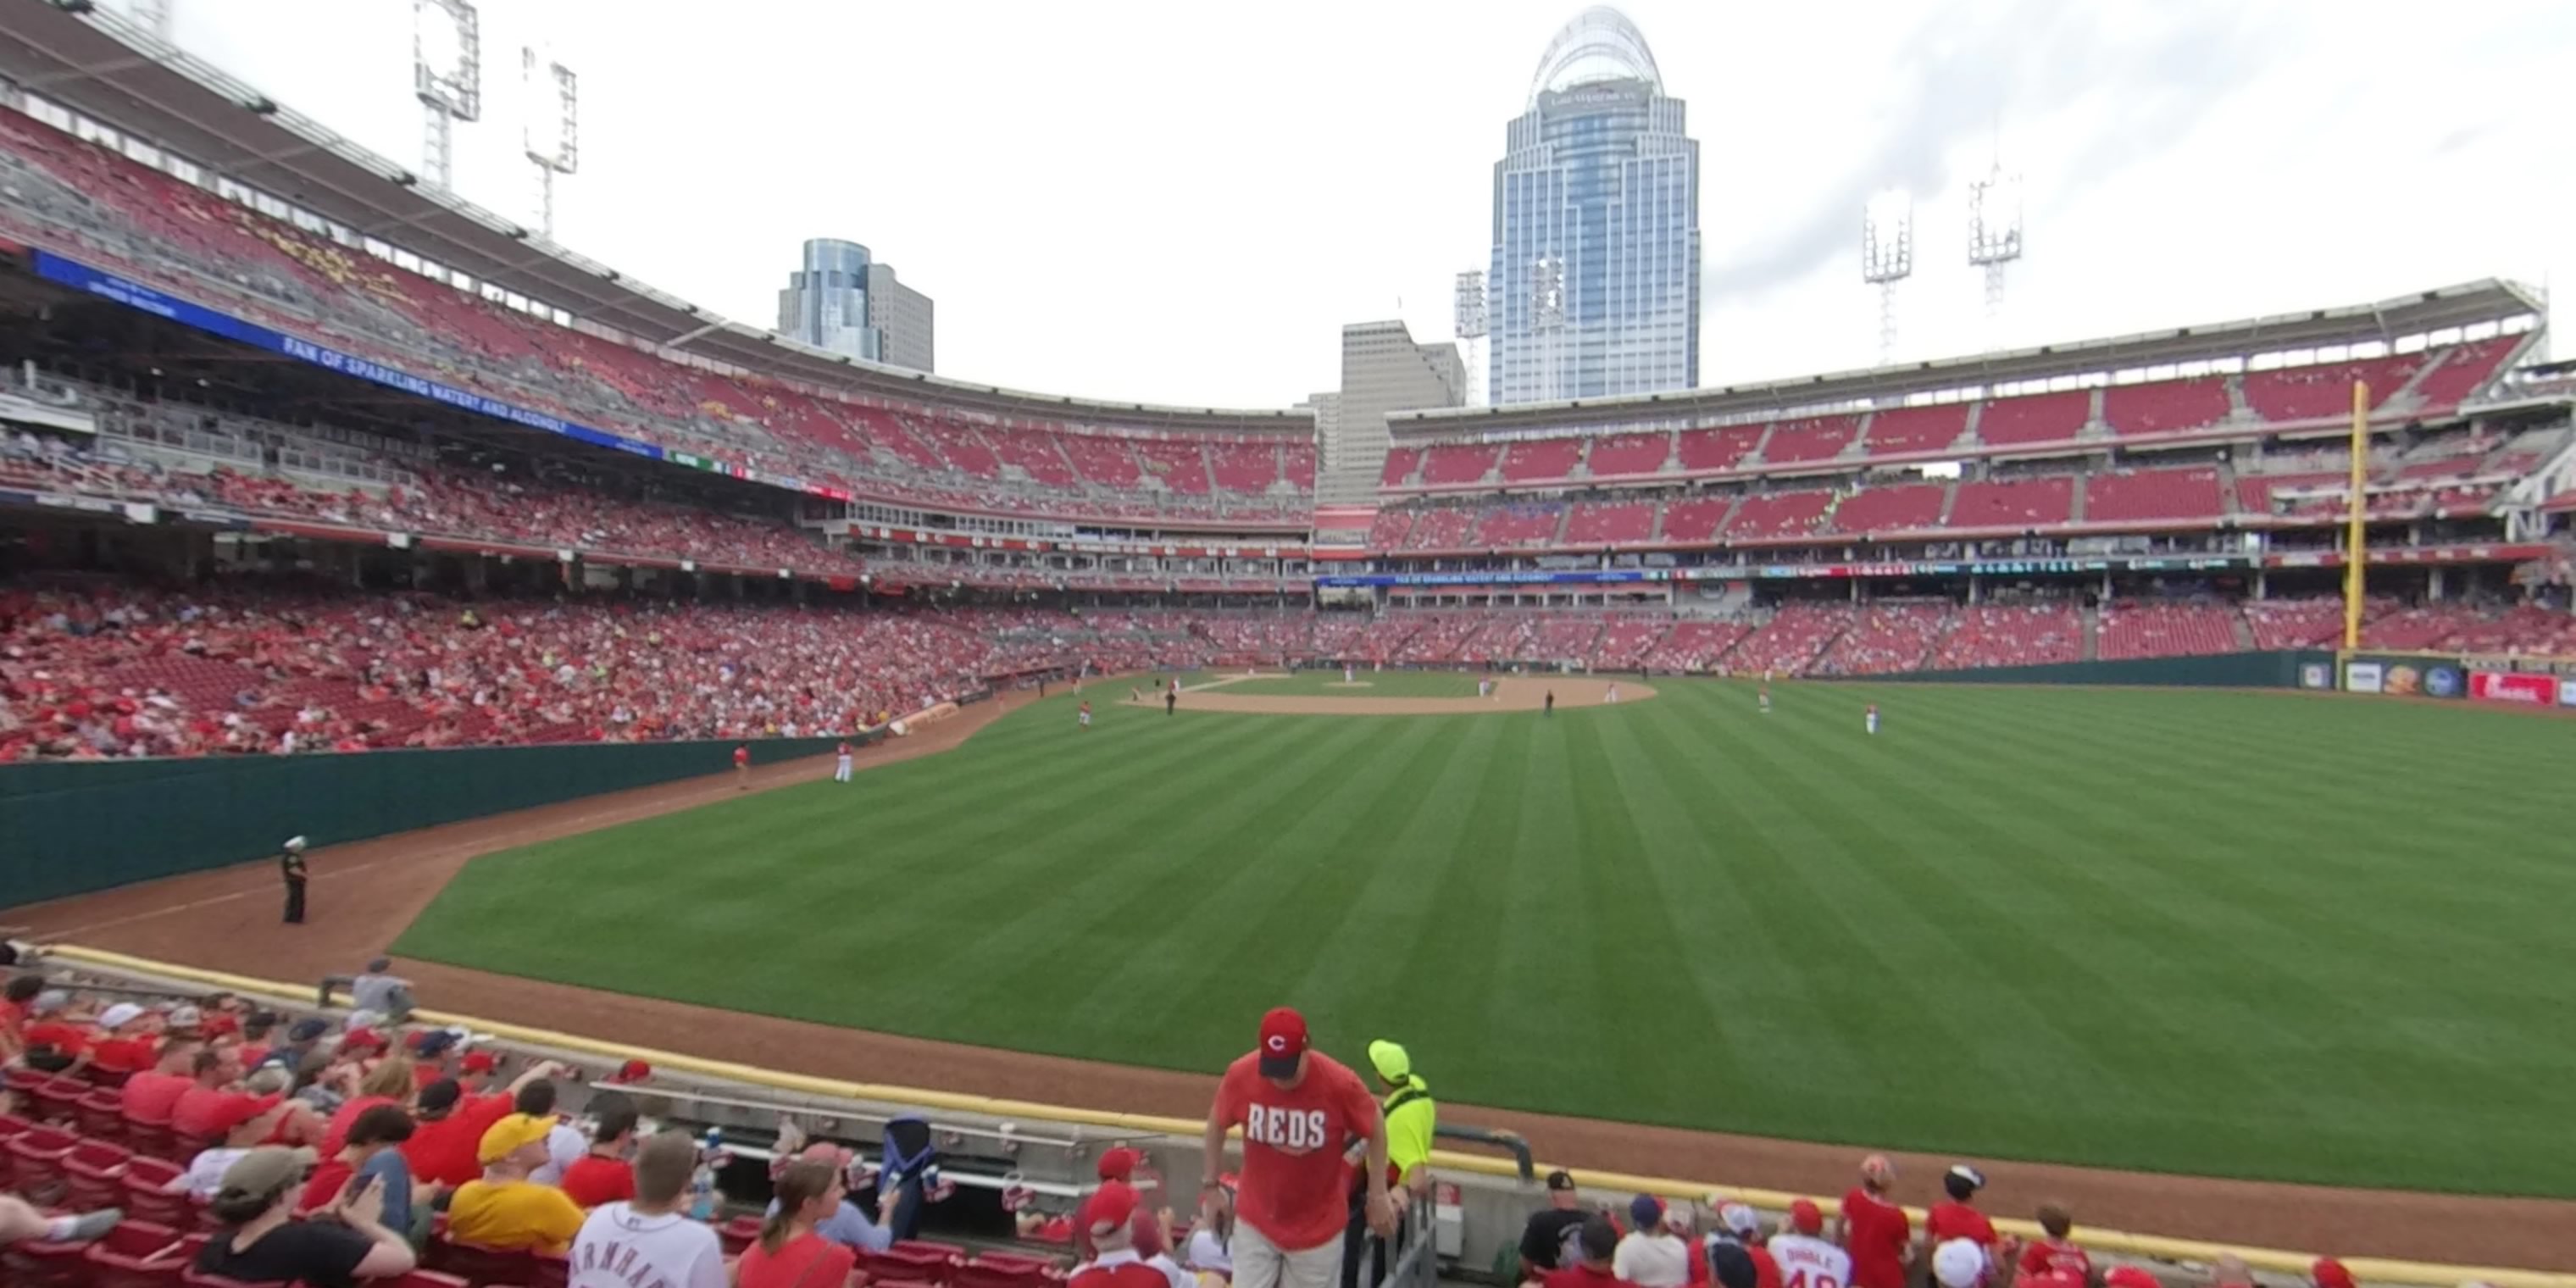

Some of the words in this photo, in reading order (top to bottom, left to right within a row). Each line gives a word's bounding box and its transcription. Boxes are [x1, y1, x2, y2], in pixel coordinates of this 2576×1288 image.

[284, 336, 317, 362] FAN
[320, 350, 342, 369] OF
[345, 358, 429, 397] SPARKLING
[481, 399, 508, 419] AND
[1267, 1034, 1286, 1052] C
[1246, 1102, 1327, 1150] REDS
